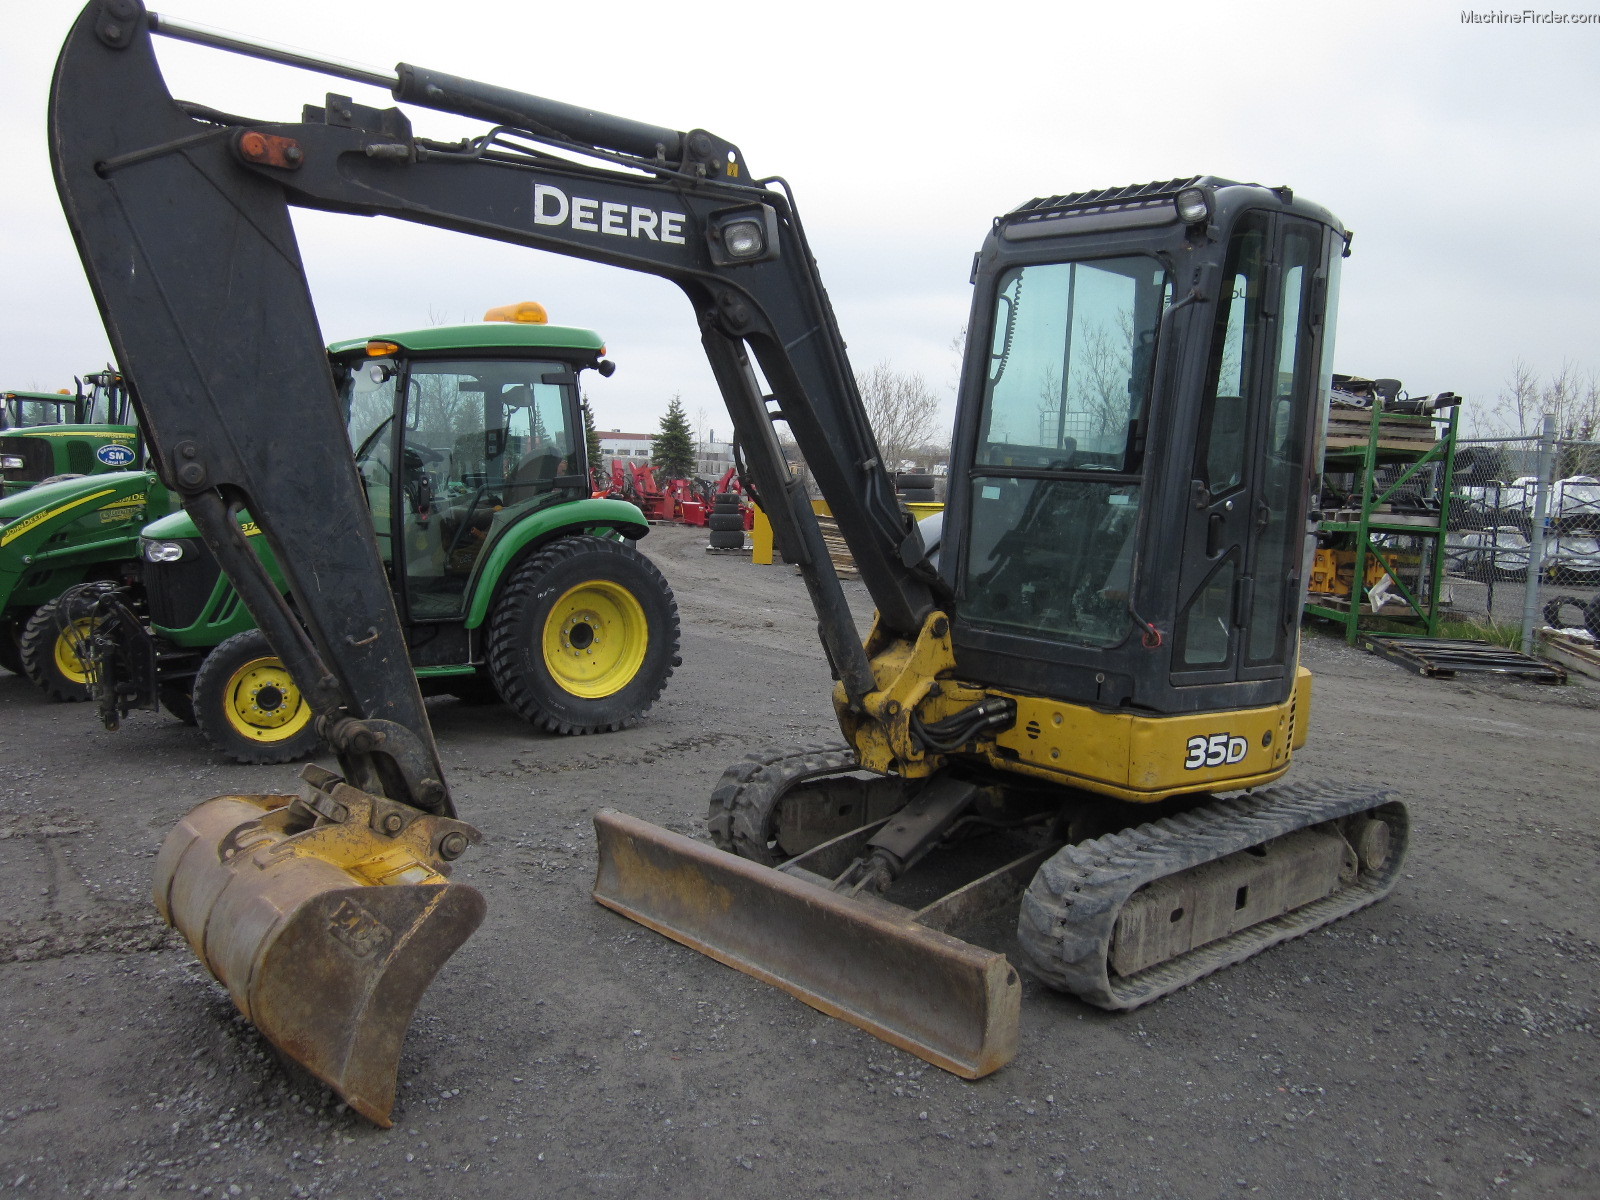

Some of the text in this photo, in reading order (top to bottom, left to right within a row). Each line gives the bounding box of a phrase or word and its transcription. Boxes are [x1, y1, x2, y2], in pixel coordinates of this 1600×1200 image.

[533, 183, 686, 245] DEERE
[108, 451, 124, 460] SM
[4, 509, 48, 537] JOHN DEERE
[1184, 731, 1249, 770] 35D
